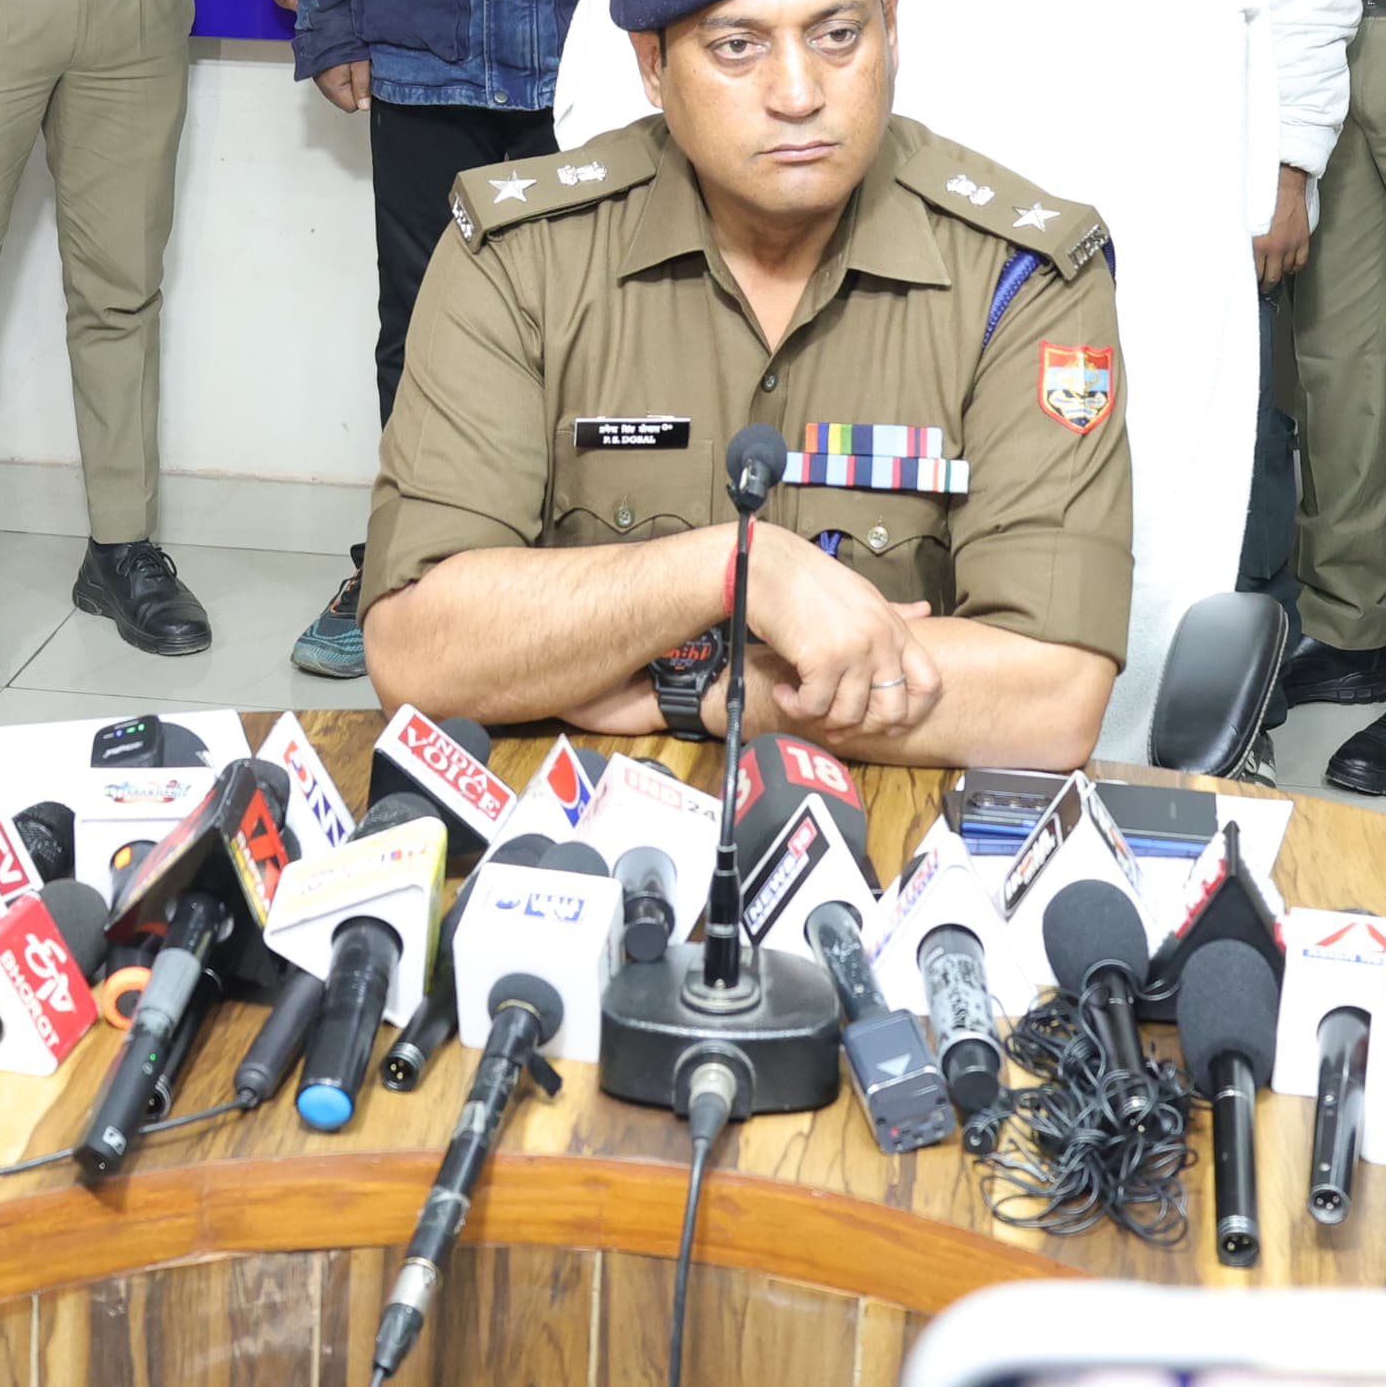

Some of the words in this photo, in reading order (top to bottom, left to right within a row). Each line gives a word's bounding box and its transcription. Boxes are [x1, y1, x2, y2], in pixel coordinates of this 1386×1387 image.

[407, 725, 502, 821] VOICE
[428, 731, 489, 791] INDIA
[785, 745, 849, 793] 18
